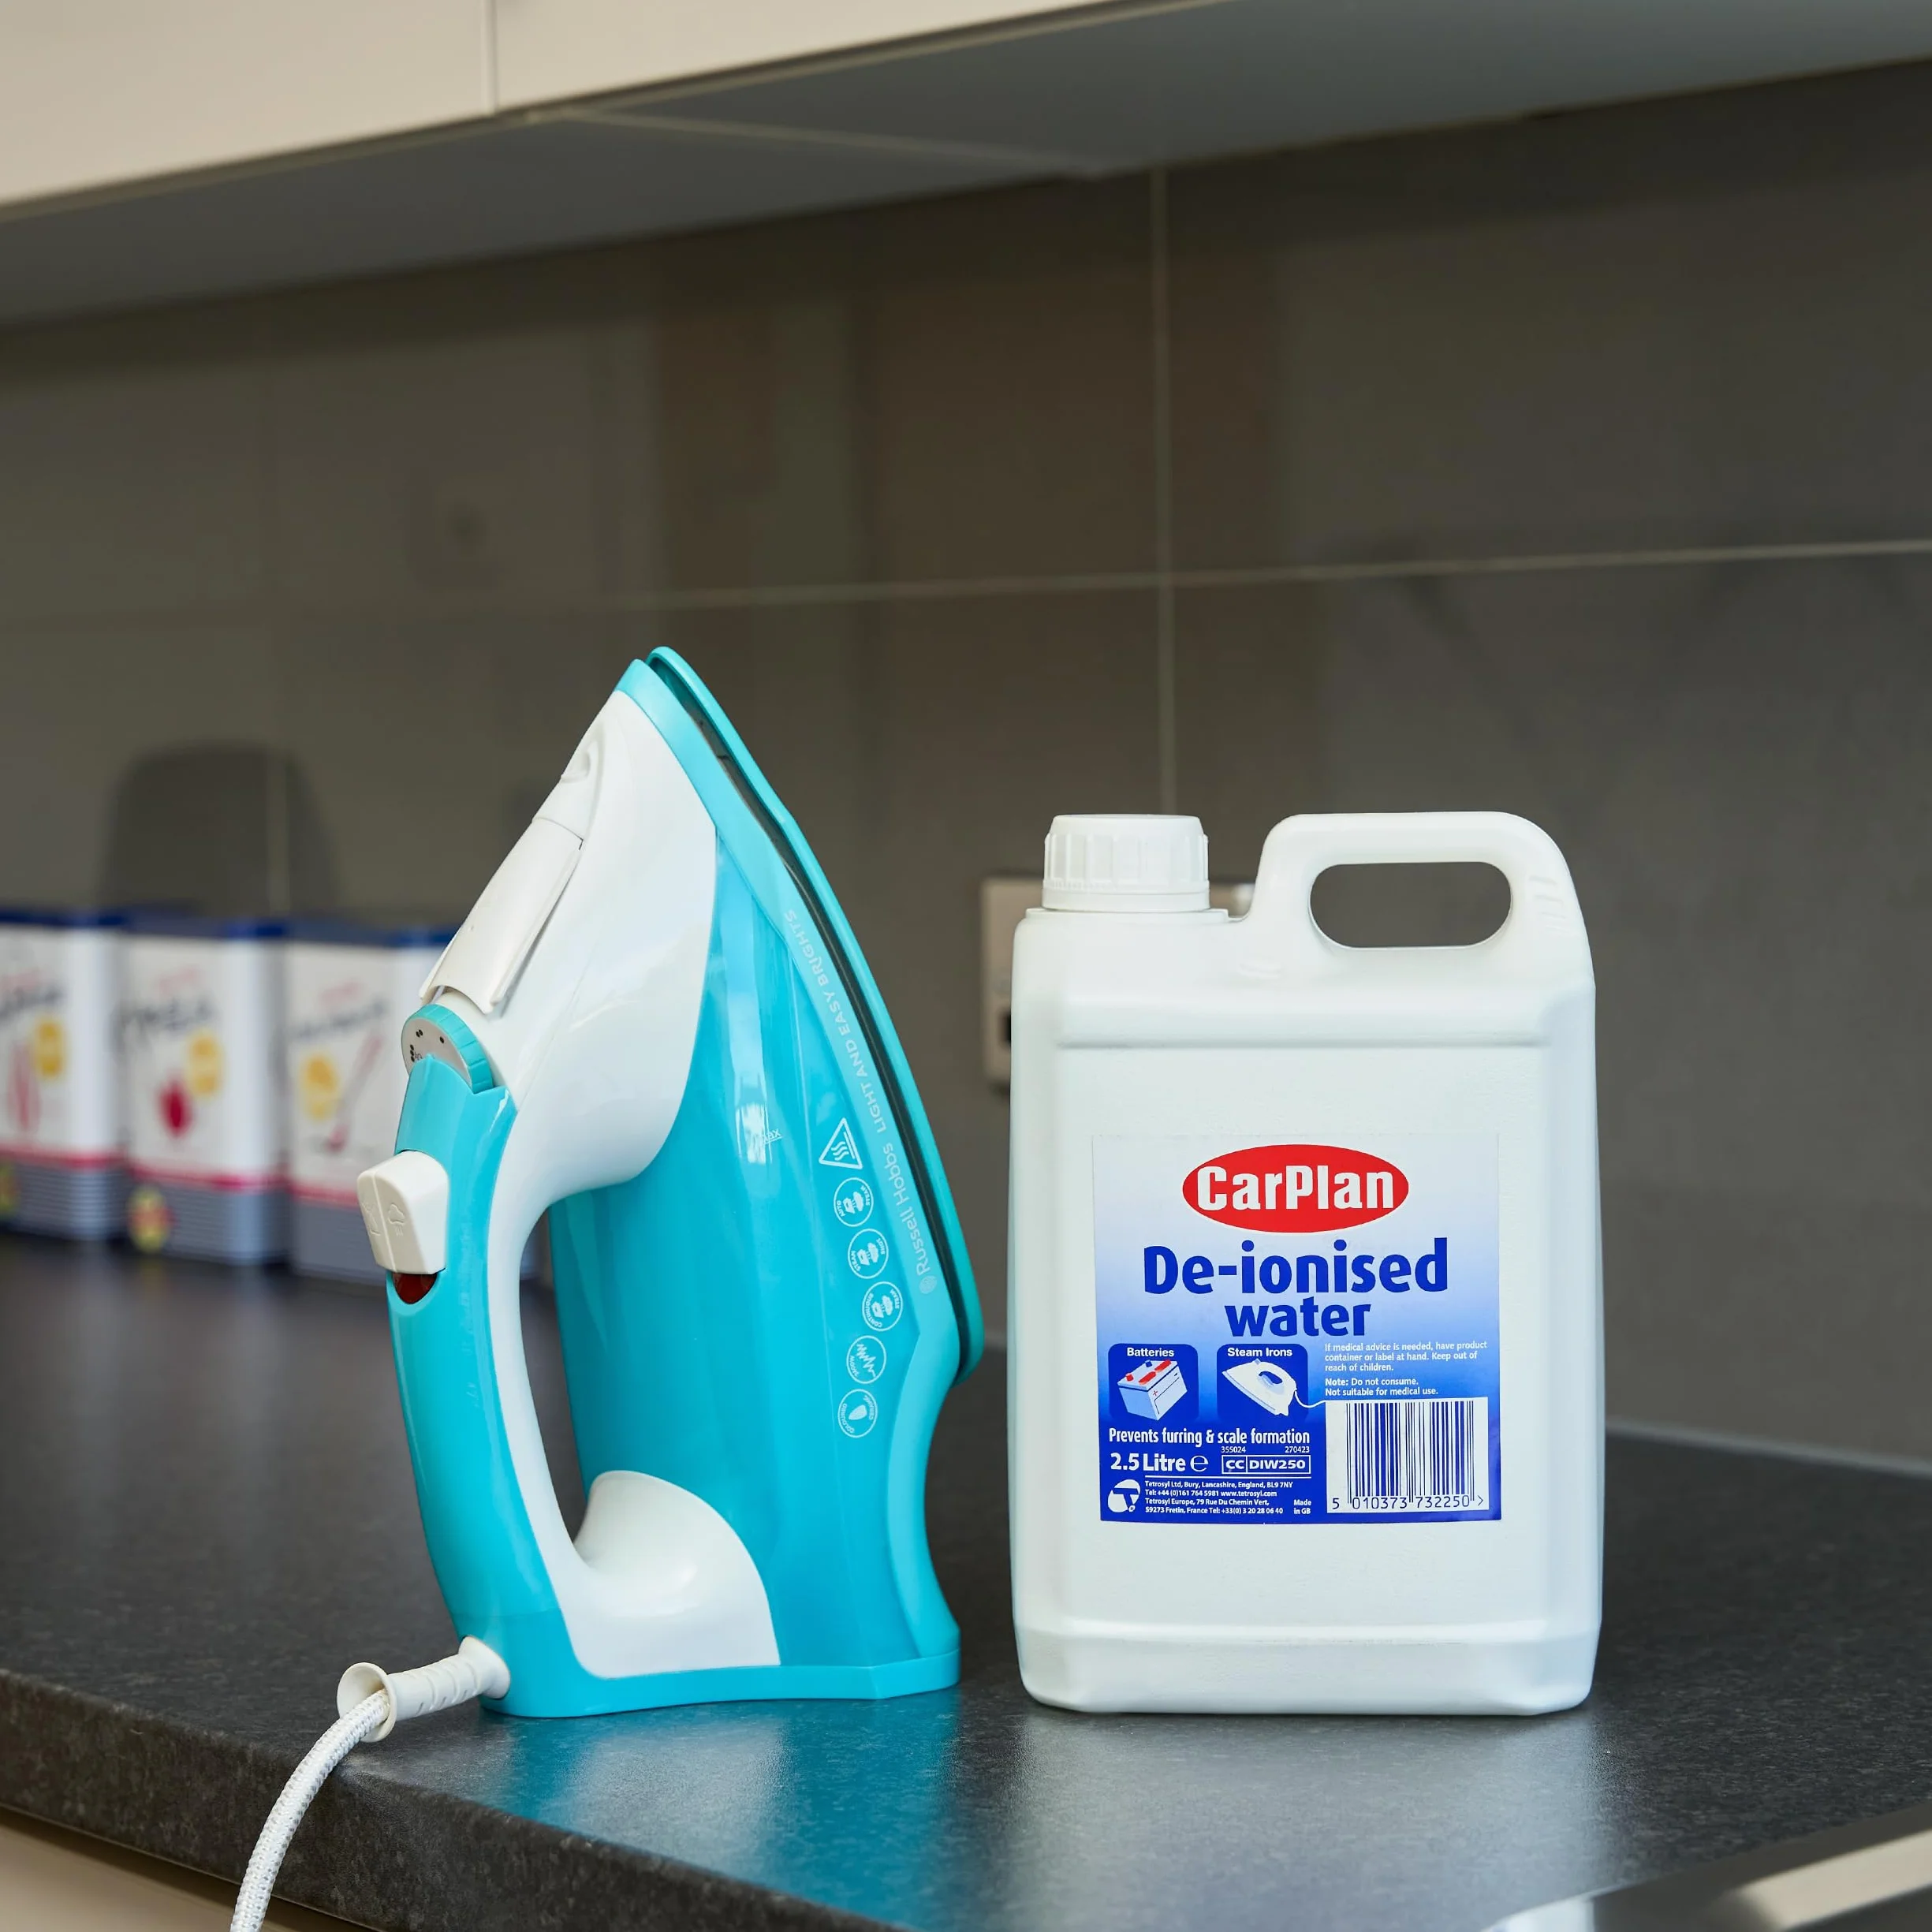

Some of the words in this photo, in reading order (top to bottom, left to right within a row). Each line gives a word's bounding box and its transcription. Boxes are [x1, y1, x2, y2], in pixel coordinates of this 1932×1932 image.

[785, 909, 829, 986] BRIGHTS
[823, 990, 850, 1035] EASY
[845, 1039, 867, 1078] AND
[860, 1082, 886, 1132] LIGHT
[883, 1143, 909, 1206] Hobbs
[860, 1185, 870, 1206] STEAM
[1196, 1166, 1393, 1211] CarPlan
[837, 1200, 845, 1218] AUTO
[876, 1238, 885, 1255] SHOT
[900, 1206, 931, 1275] Russell
[851, 1251, 861, 1271] STEAM
[1143, 1237, 1447, 1294] De-ionised
[890, 1289, 900, 1309] STEAM
[866, 1293, 882, 1328] CONTINUOUS
[1224, 1296, 1371, 1337] water
[1127, 1348, 1174, 1358] Batteries
[1228, 1347, 1263, 1357] Steam
[1266, 1346, 1292, 1357] Irons
[1402, 1342, 1433, 1351] needed,
[1457, 1341, 1487, 1350] product
[1432, 1352, 1451, 1361] Keep
[1360, 1363, 1393, 1371] children.
[863, 1395, 875, 1420] CERAMIC
[840, 1404, 855, 1434] COLOURED
[1110, 1428, 1158, 1443] Prevents
[1162, 1428, 1202, 1447] furring
[1207, 1430, 1214, 1443] &
[1218, 1428, 1247, 1444] scale
[1251, 1428, 1310, 1444] formation
[1110, 1453, 1139, 1471] 2.5
[1143, 1453, 1186, 1471] Litre
[1225, 1460, 1244, 1469] CC
[1249, 1460, 1306, 1469] DIW250
[1332, 1498, 1339, 1509] 5
[1352, 1497, 1408, 1509] 010373
[1415, 1495, 1470, 1508] 732250
